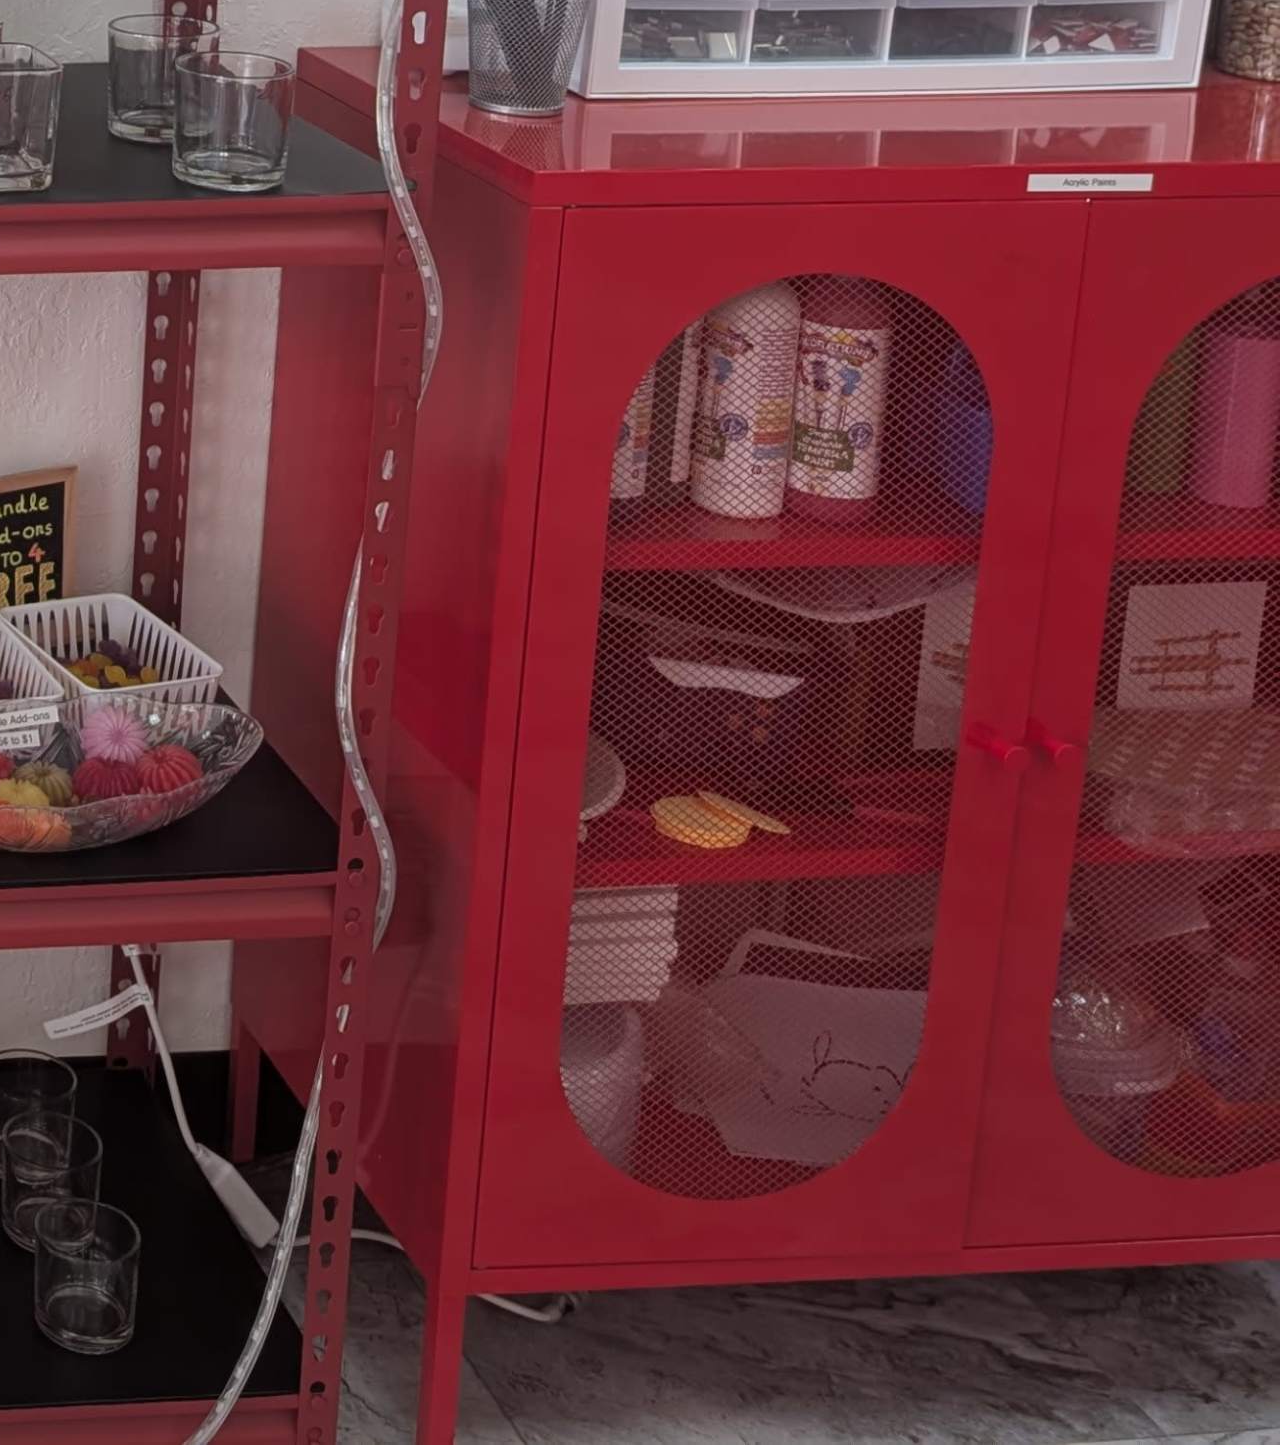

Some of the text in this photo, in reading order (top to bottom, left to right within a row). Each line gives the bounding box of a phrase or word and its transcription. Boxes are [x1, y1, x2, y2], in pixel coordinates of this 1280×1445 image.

[1062, 177, 1117, 187] Acrylic Paints
[27, 541, 46, 563] 4
[9, 712, 51, 724] Add-ons
[10, 733, 33, 745] to $1
